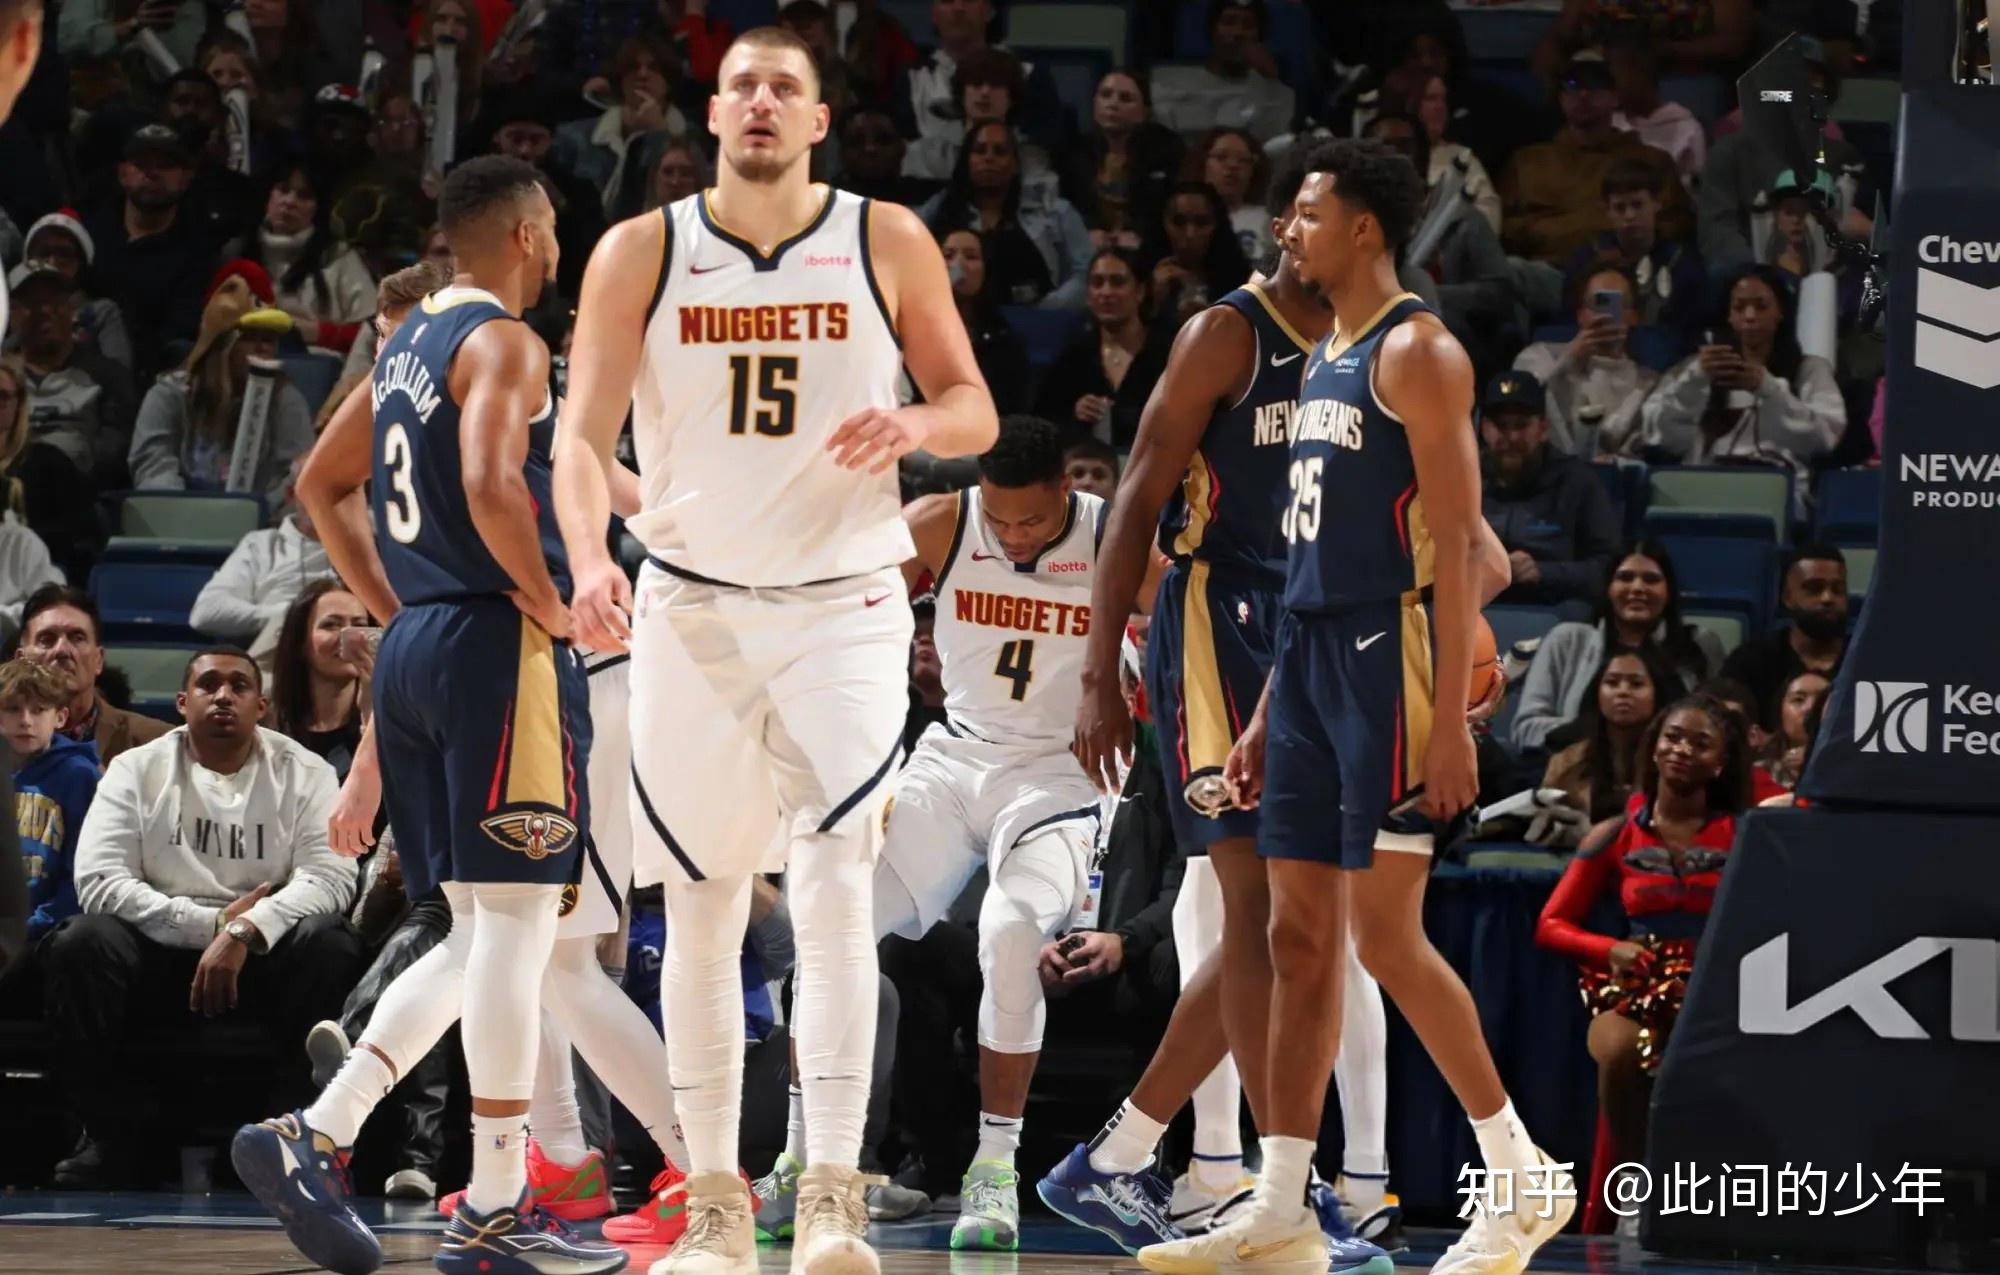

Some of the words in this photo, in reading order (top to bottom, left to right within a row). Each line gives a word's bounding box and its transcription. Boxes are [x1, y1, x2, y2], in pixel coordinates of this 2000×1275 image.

[804, 255, 852, 267] ibotta
[1918, 234, 2000, 264] Chev
[679, 302, 849, 345] NUGGETS
[728, 353, 800, 438] 15
[384, 422, 421, 544] 3
[1913, 491, 2000, 508] PRODU
[1047, 561, 1087, 573] ibotta
[954, 588, 1092, 637] NUGGETS
[994, 639, 1035, 702] 4
[1944, 684, 2000, 716] Ke
